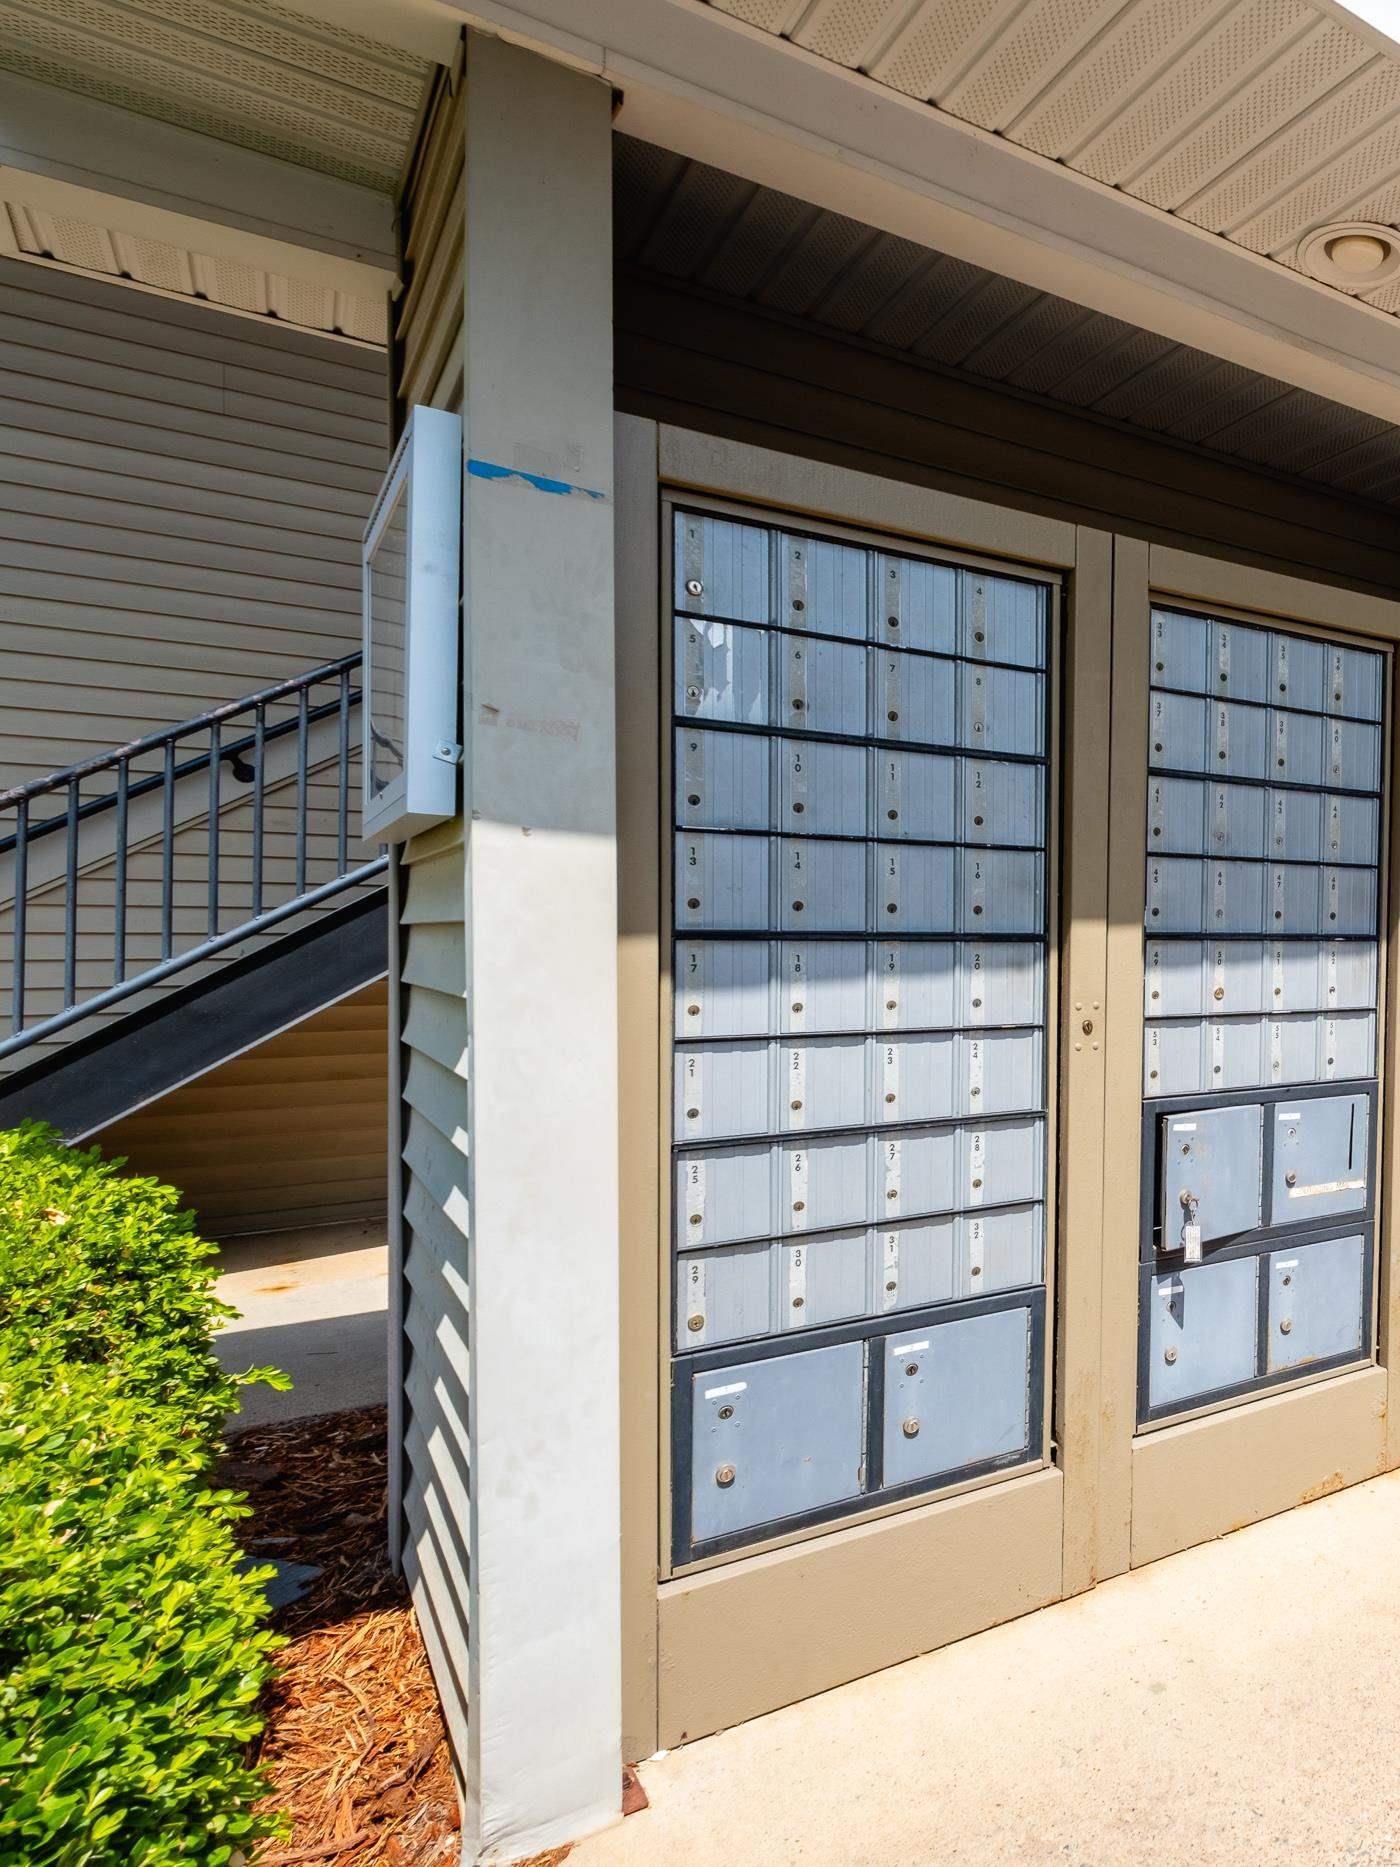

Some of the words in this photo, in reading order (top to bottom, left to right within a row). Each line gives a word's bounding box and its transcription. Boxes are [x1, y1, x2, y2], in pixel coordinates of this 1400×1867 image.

[687, 528, 696, 539] 1
[794, 550, 802, 561] 2
[889, 569, 897, 579] 3
[975, 587, 983, 596] 4
[688, 633, 697, 644] 5
[794, 650, 802, 660] 6
[889, 663, 896, 673] 7
[975, 677, 982, 686] 8
[689, 742, 698, 752] 9
[794, 753, 802, 773] 10
[890, 763, 895, 781] 11
[975, 771, 982, 789] 12
[689, 846, 697, 866] 13
[793, 851, 801, 870] 14
[889, 857, 896, 876] 15
[974, 862, 981, 880] 16
[690, 953, 698, 973] 17
[794, 954, 802, 973] 18
[888, 953, 896, 972] 19
[974, 953, 981, 971] 20
[887, 1047, 893, 1065] 23
[972, 1042, 979, 1059] 24
[688, 1058, 696, 1078] 21
[792, 1051, 800, 1071] 22
[889, 1143, 896, 1161] 27
[974, 1135, 980, 1152] 28
[794, 1153, 802, 1172] 26
[691, 1165, 699, 1184] 25
[973, 1222, 980, 1240] 32
[888, 1235, 896, 1253] 31
[794, 1249, 802, 1268] 30
[691, 1265, 700, 1285] 29
